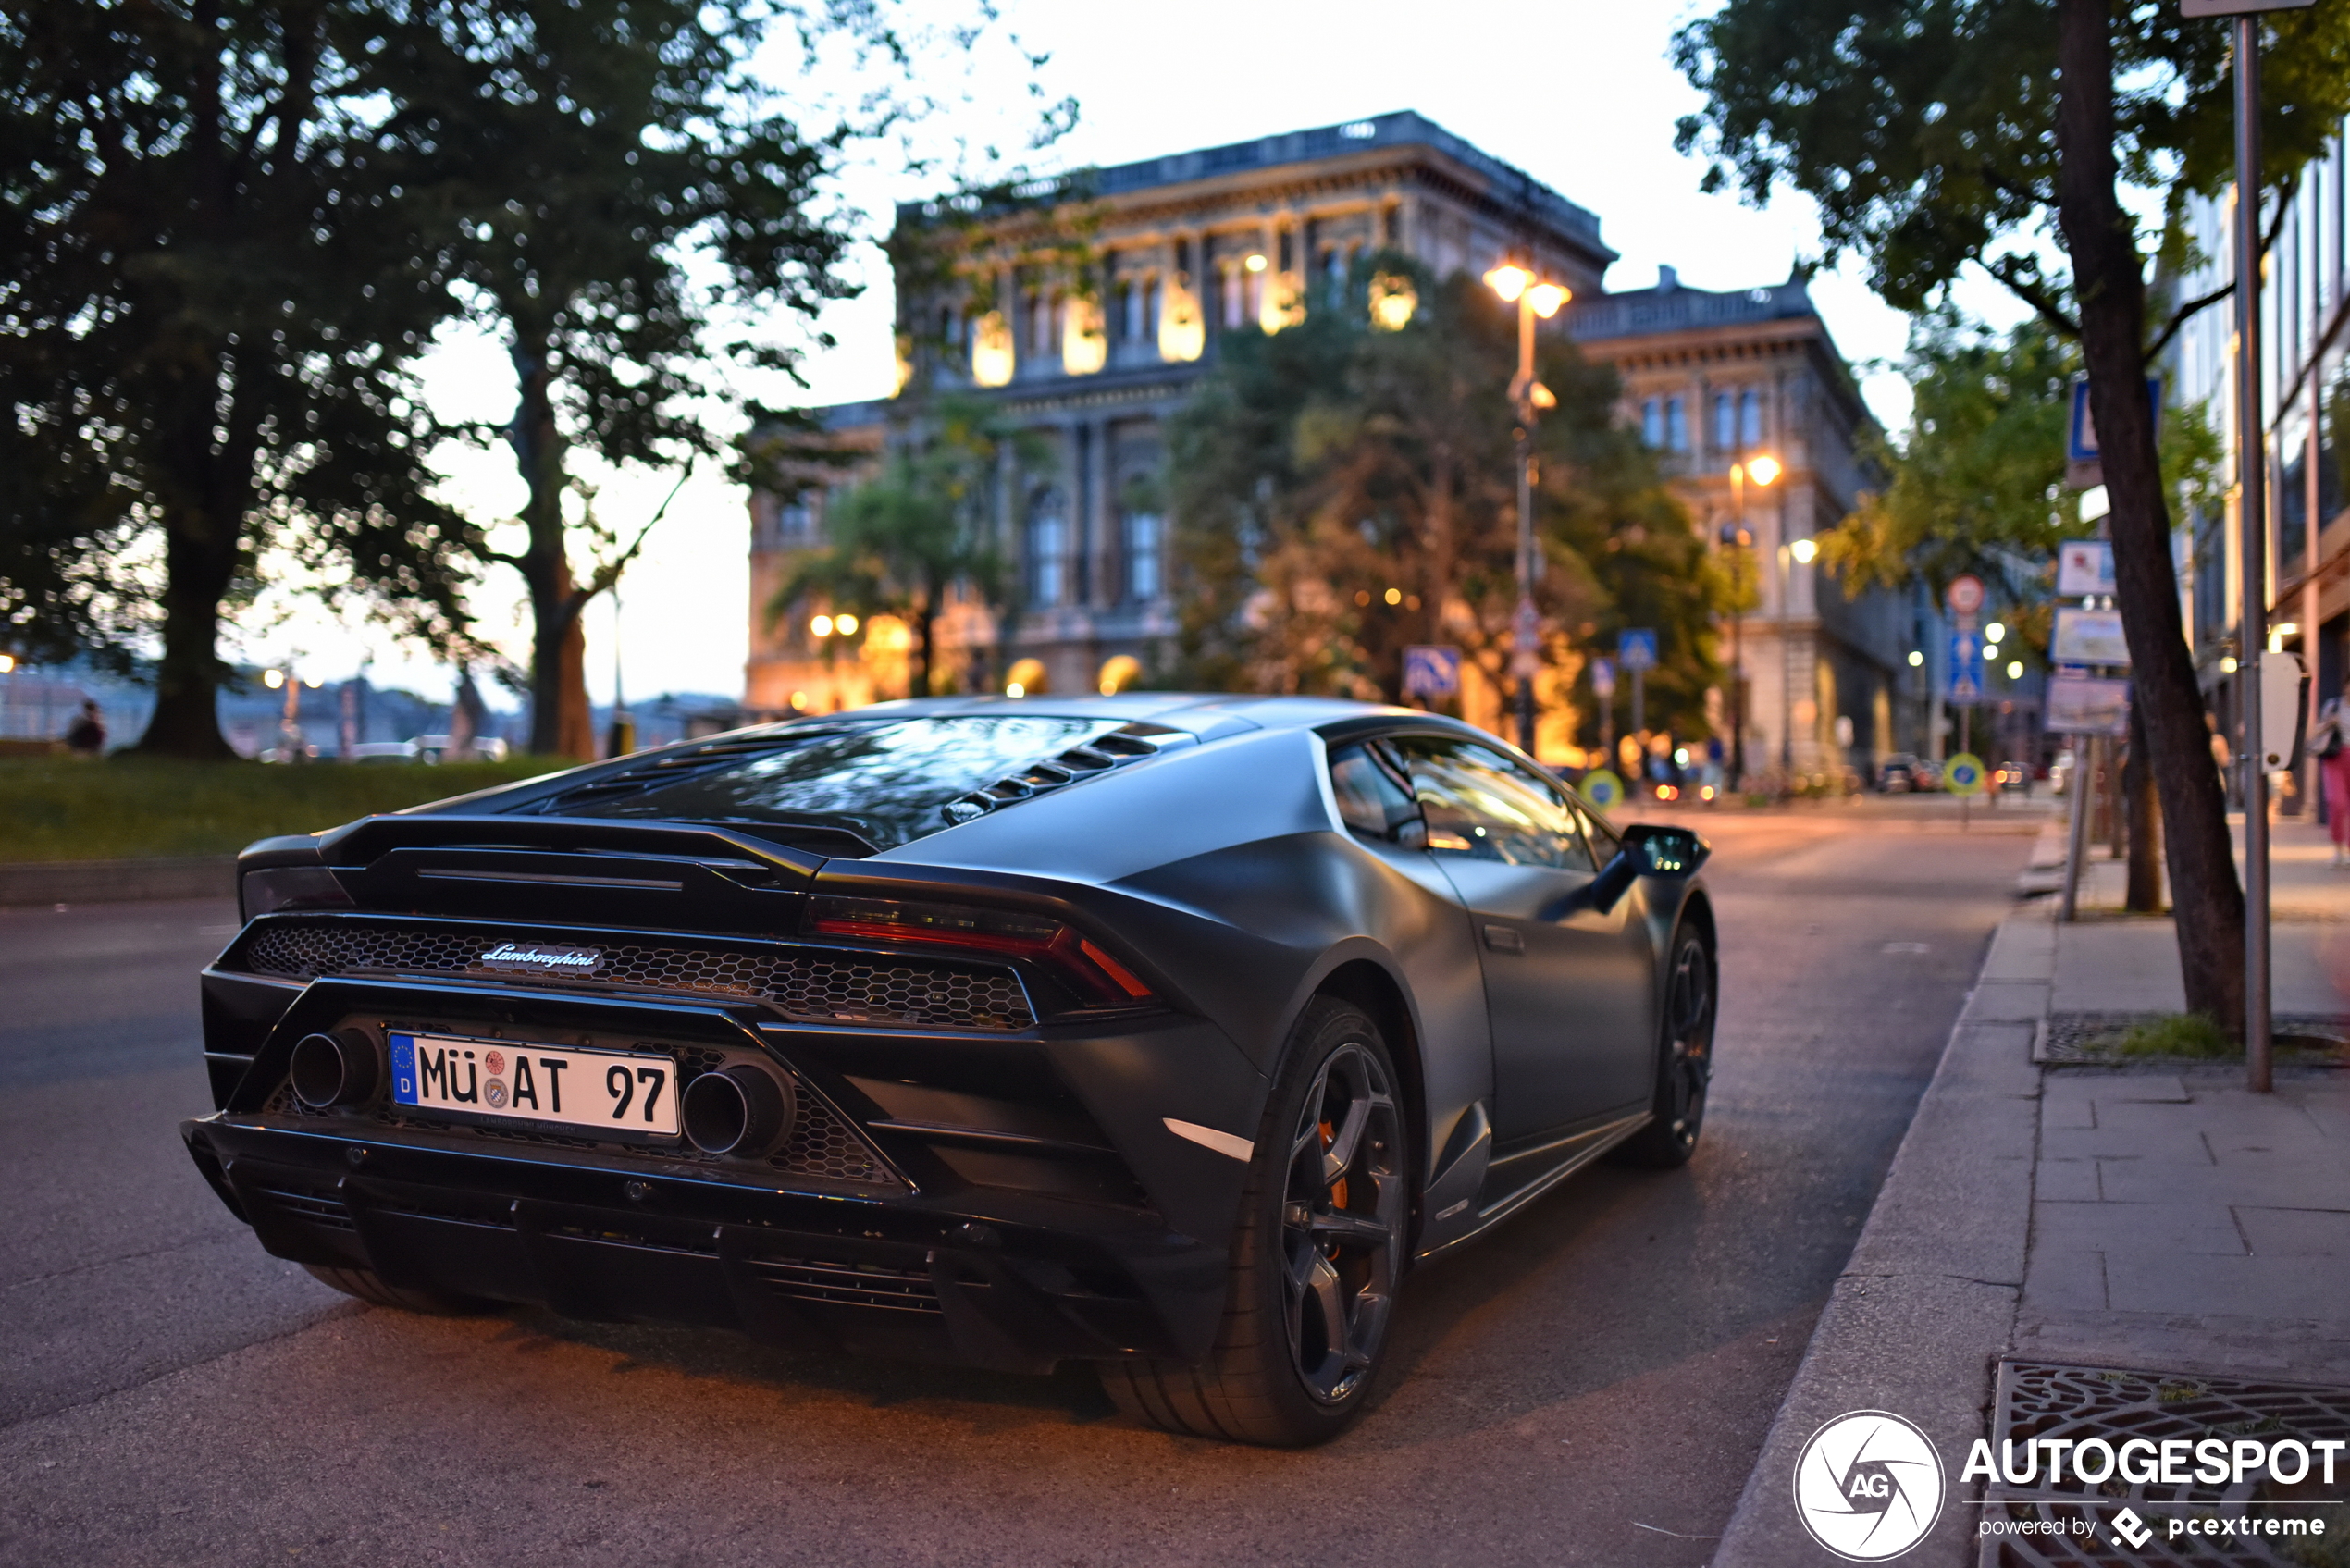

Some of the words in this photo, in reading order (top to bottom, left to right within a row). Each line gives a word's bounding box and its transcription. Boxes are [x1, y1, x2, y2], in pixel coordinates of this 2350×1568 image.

[481, 943, 598, 968] Lamborghini
[401, 1078, 410, 1093] D
[419, 1045, 477, 1104] MÜ
[512, 1054, 568, 1113] AT
[606, 1064, 665, 1122] 97
